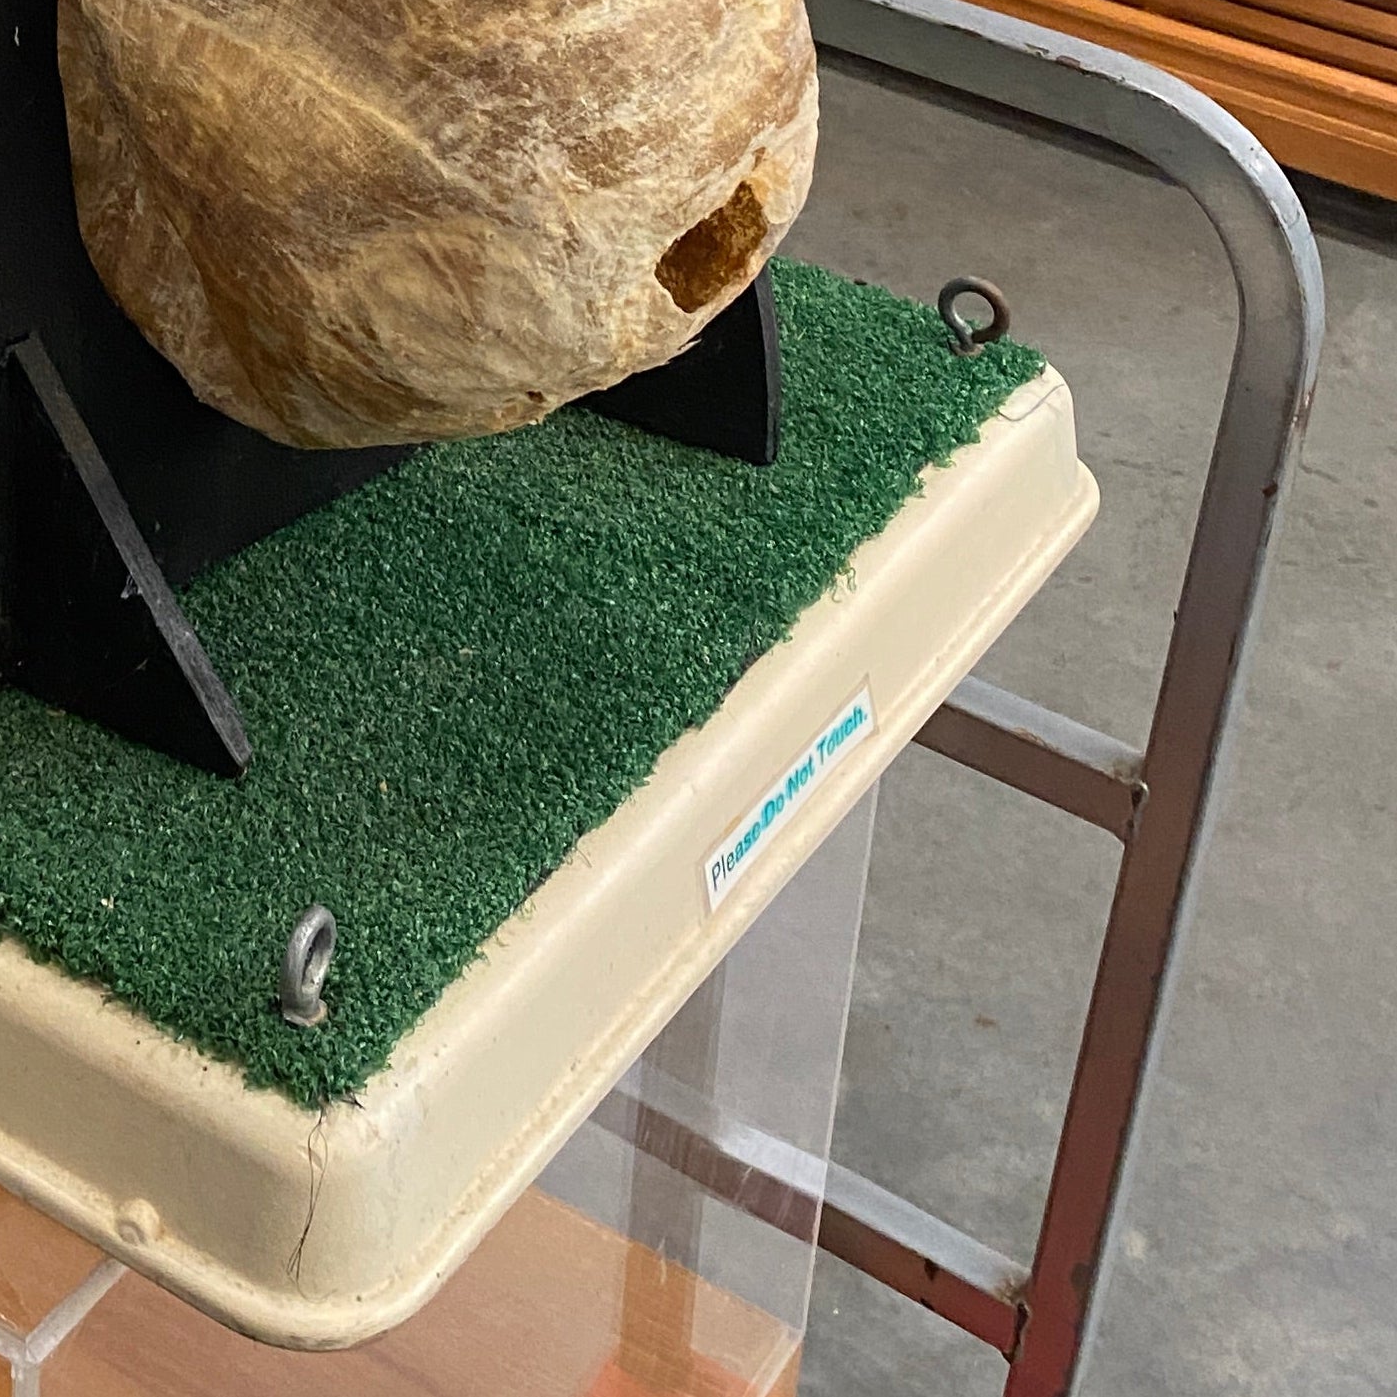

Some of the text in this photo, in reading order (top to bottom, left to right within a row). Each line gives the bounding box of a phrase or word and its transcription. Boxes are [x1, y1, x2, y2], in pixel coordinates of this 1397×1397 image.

[711, 705, 868, 891] Please Do Not Touch.
